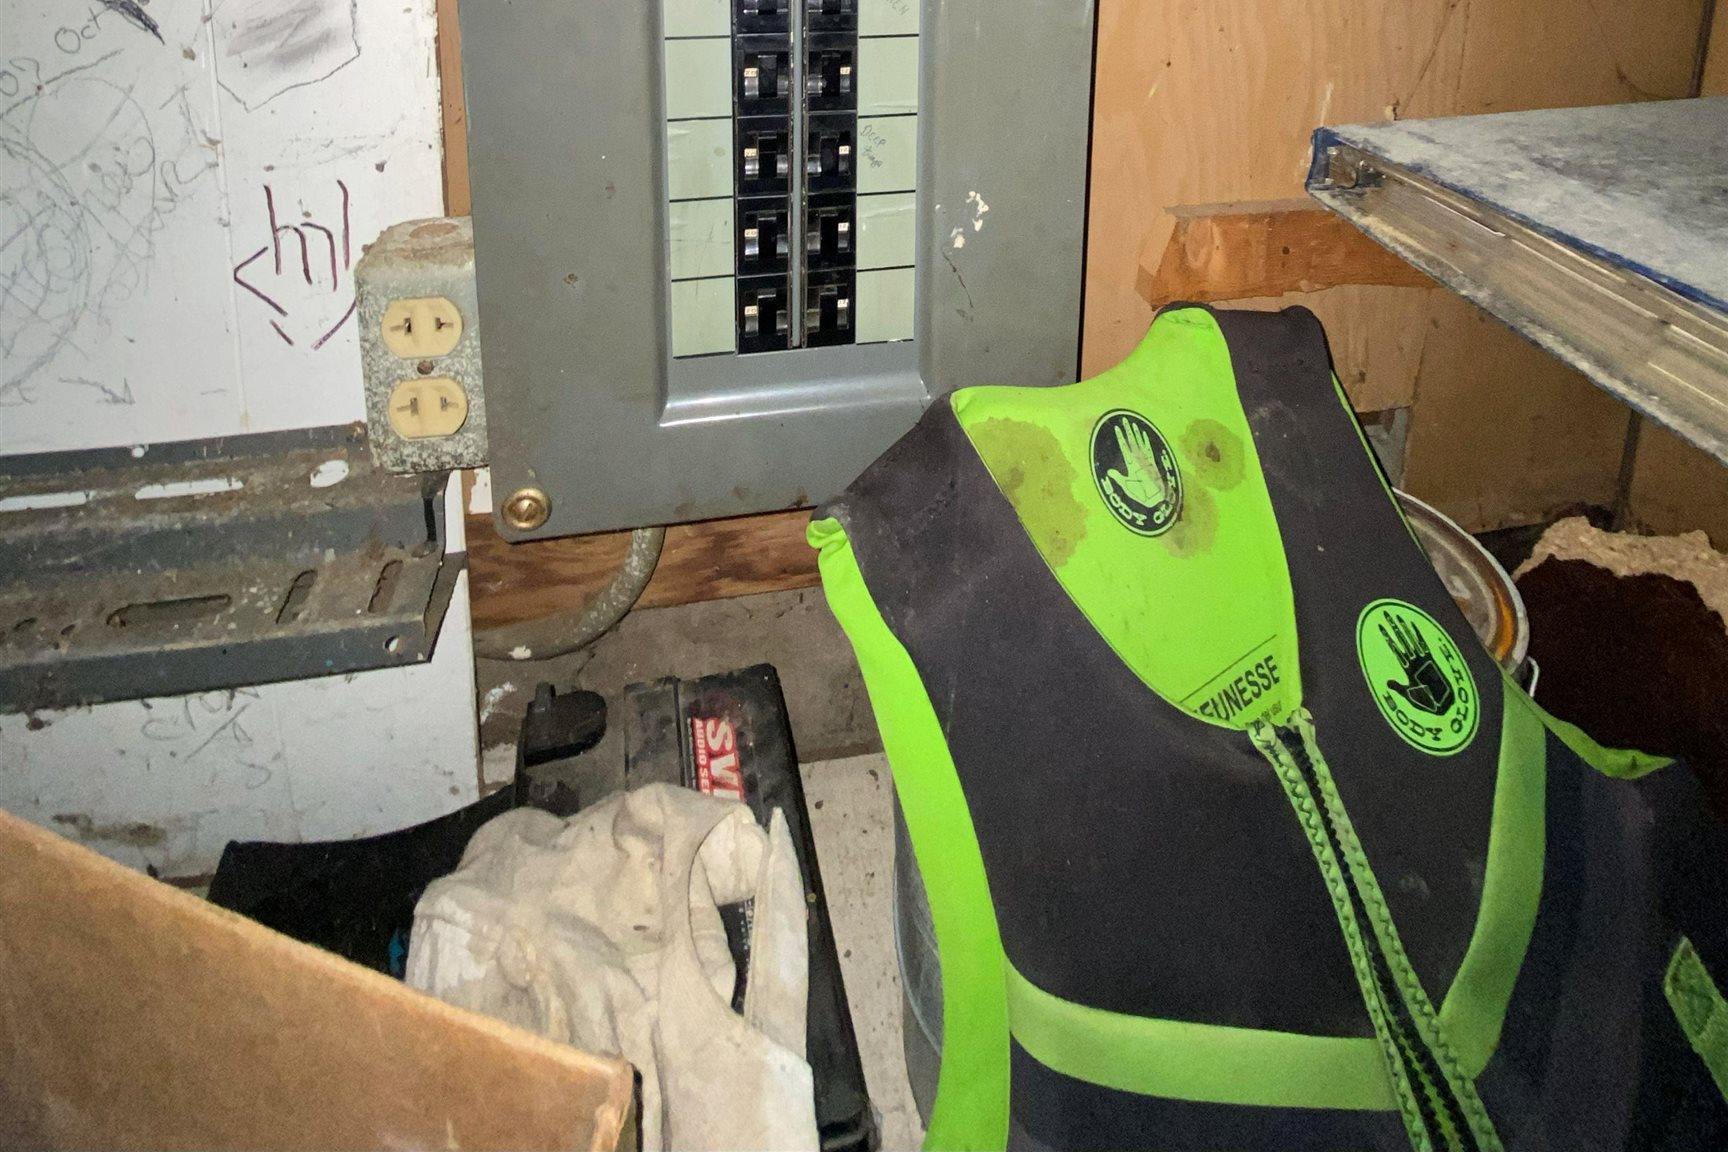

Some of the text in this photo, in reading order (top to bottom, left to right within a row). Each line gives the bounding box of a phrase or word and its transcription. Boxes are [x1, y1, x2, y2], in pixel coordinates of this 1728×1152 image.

[1101, 476, 1148, 526] BODY
[1197, 654, 1281, 723] EUNESSE
[1382, 691, 1443, 742] BODY
[694, 718, 706, 766] AUDIO
